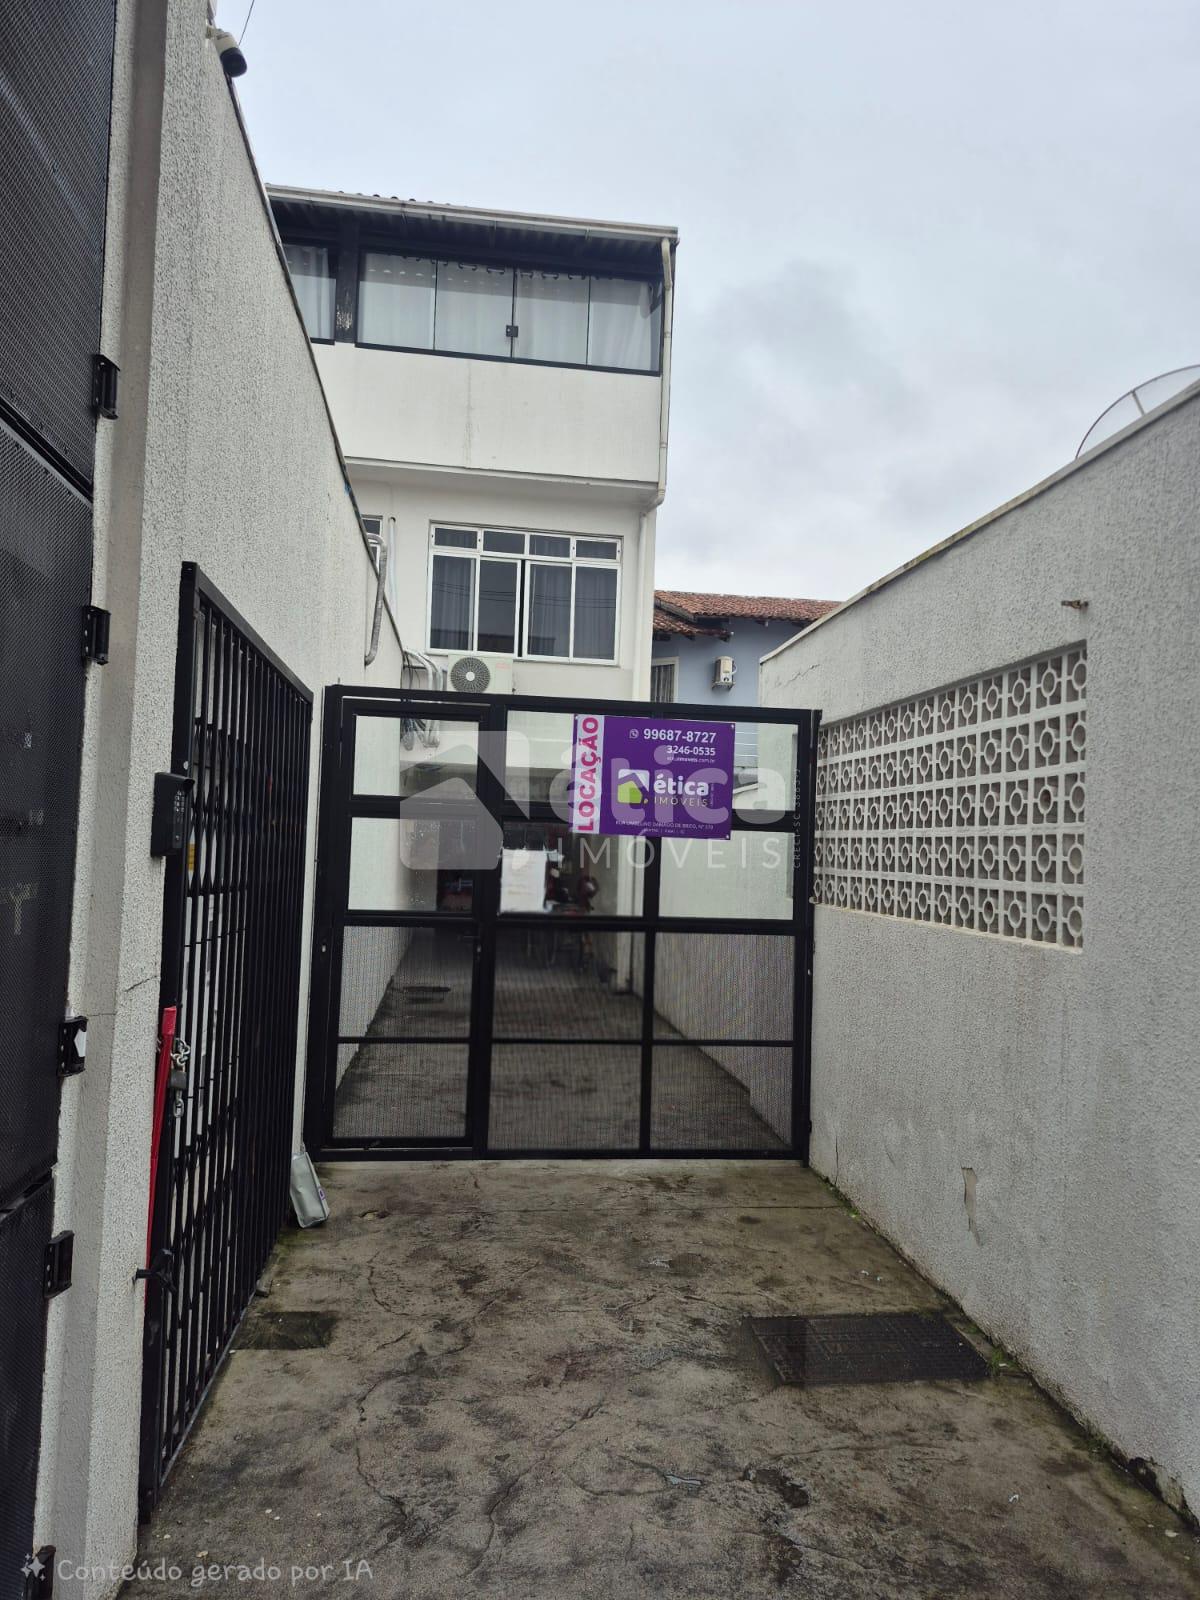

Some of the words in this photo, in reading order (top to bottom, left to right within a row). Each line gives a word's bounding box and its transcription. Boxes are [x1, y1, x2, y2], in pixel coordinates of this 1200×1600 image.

[643, 728, 717, 743] 99687-8727
[666, 745, 716, 756] 3246-0535
[577, 717, 602, 831] LOCAÇÃO
[653, 773, 709, 796] ética
